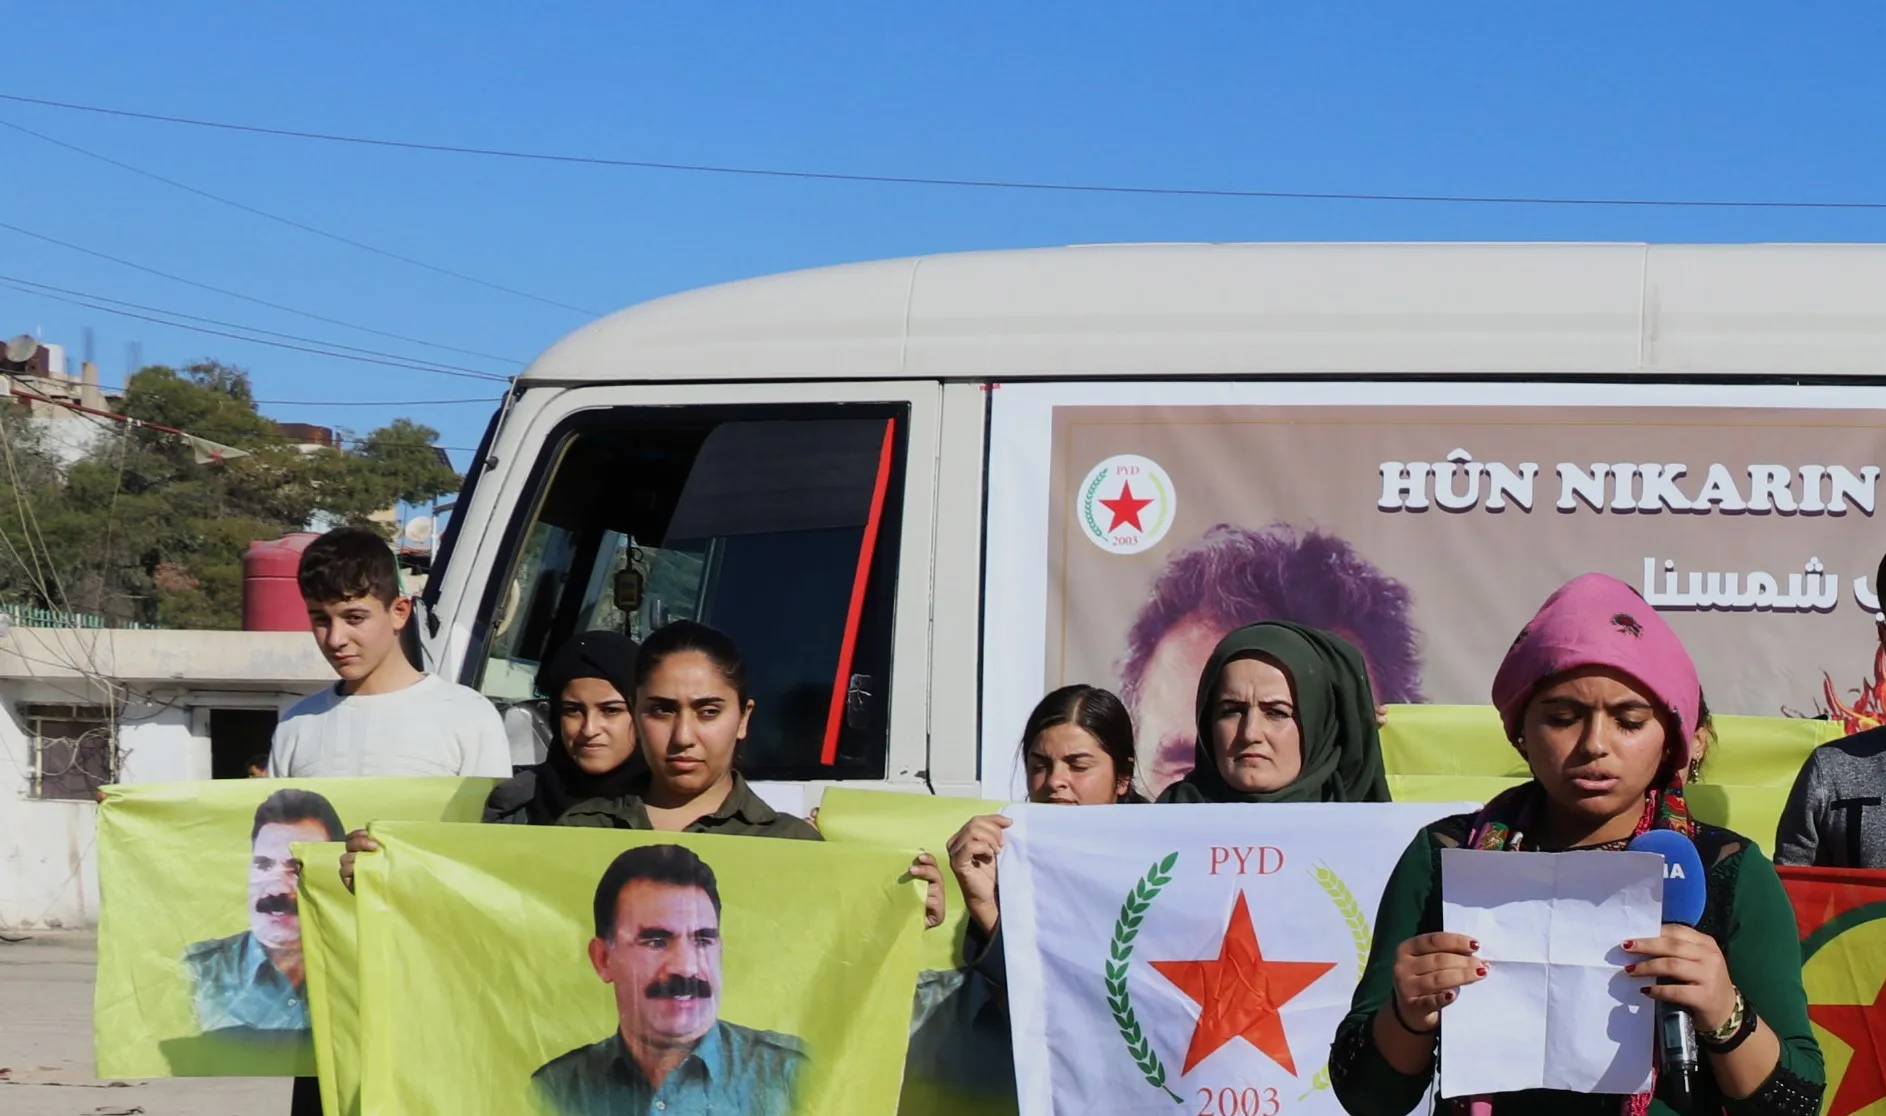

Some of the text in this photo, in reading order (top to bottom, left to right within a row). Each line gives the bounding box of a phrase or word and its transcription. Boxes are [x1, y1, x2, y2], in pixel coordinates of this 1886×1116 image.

[1116, 465, 1140, 476] PYD
[1378, 447, 1539, 512] HÛN
[1556, 463, 1881, 516] NIKARIN
[1643, 556, 1839, 612] شمسنا
[1208, 846, 1284, 876] PYD
